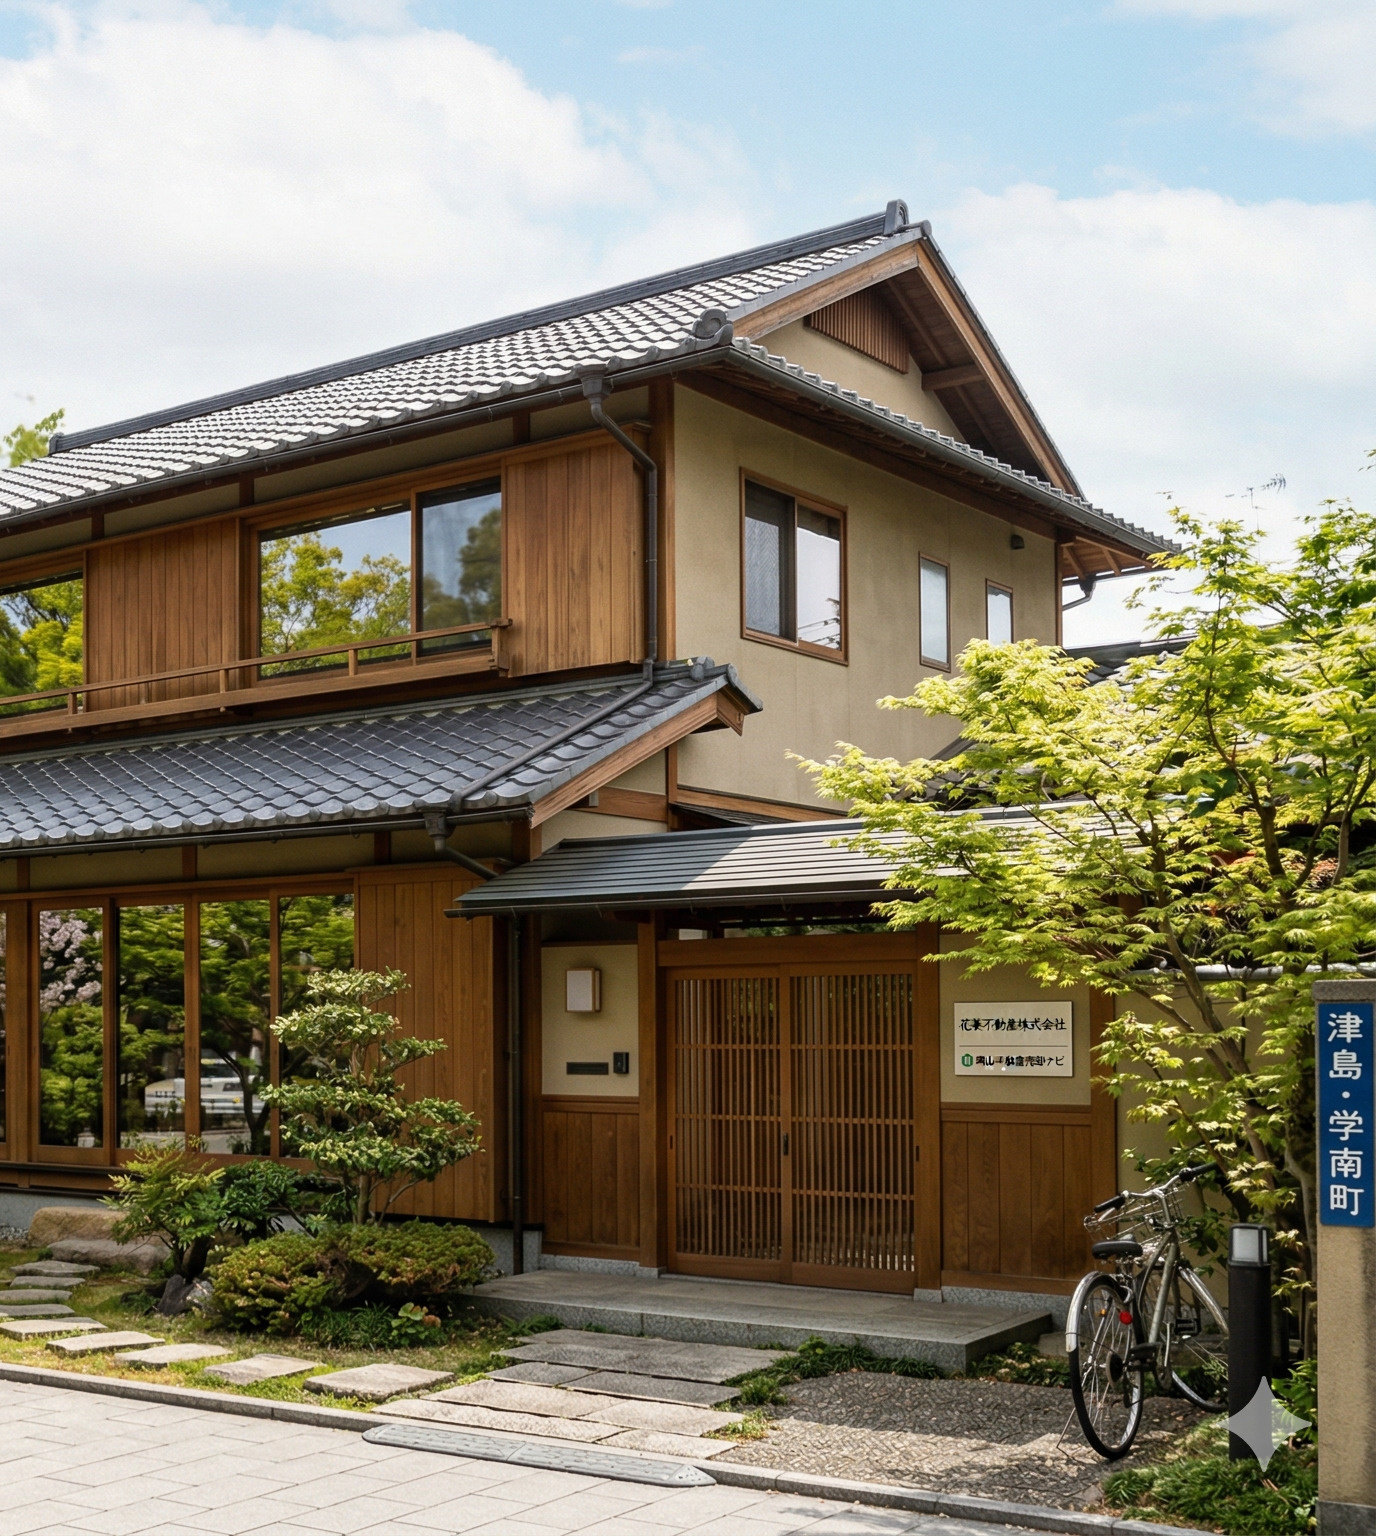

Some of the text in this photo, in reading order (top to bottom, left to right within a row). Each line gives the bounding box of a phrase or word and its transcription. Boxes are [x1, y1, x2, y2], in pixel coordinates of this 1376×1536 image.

[1327, 1011, 1365, 1216] 津島・学南町
